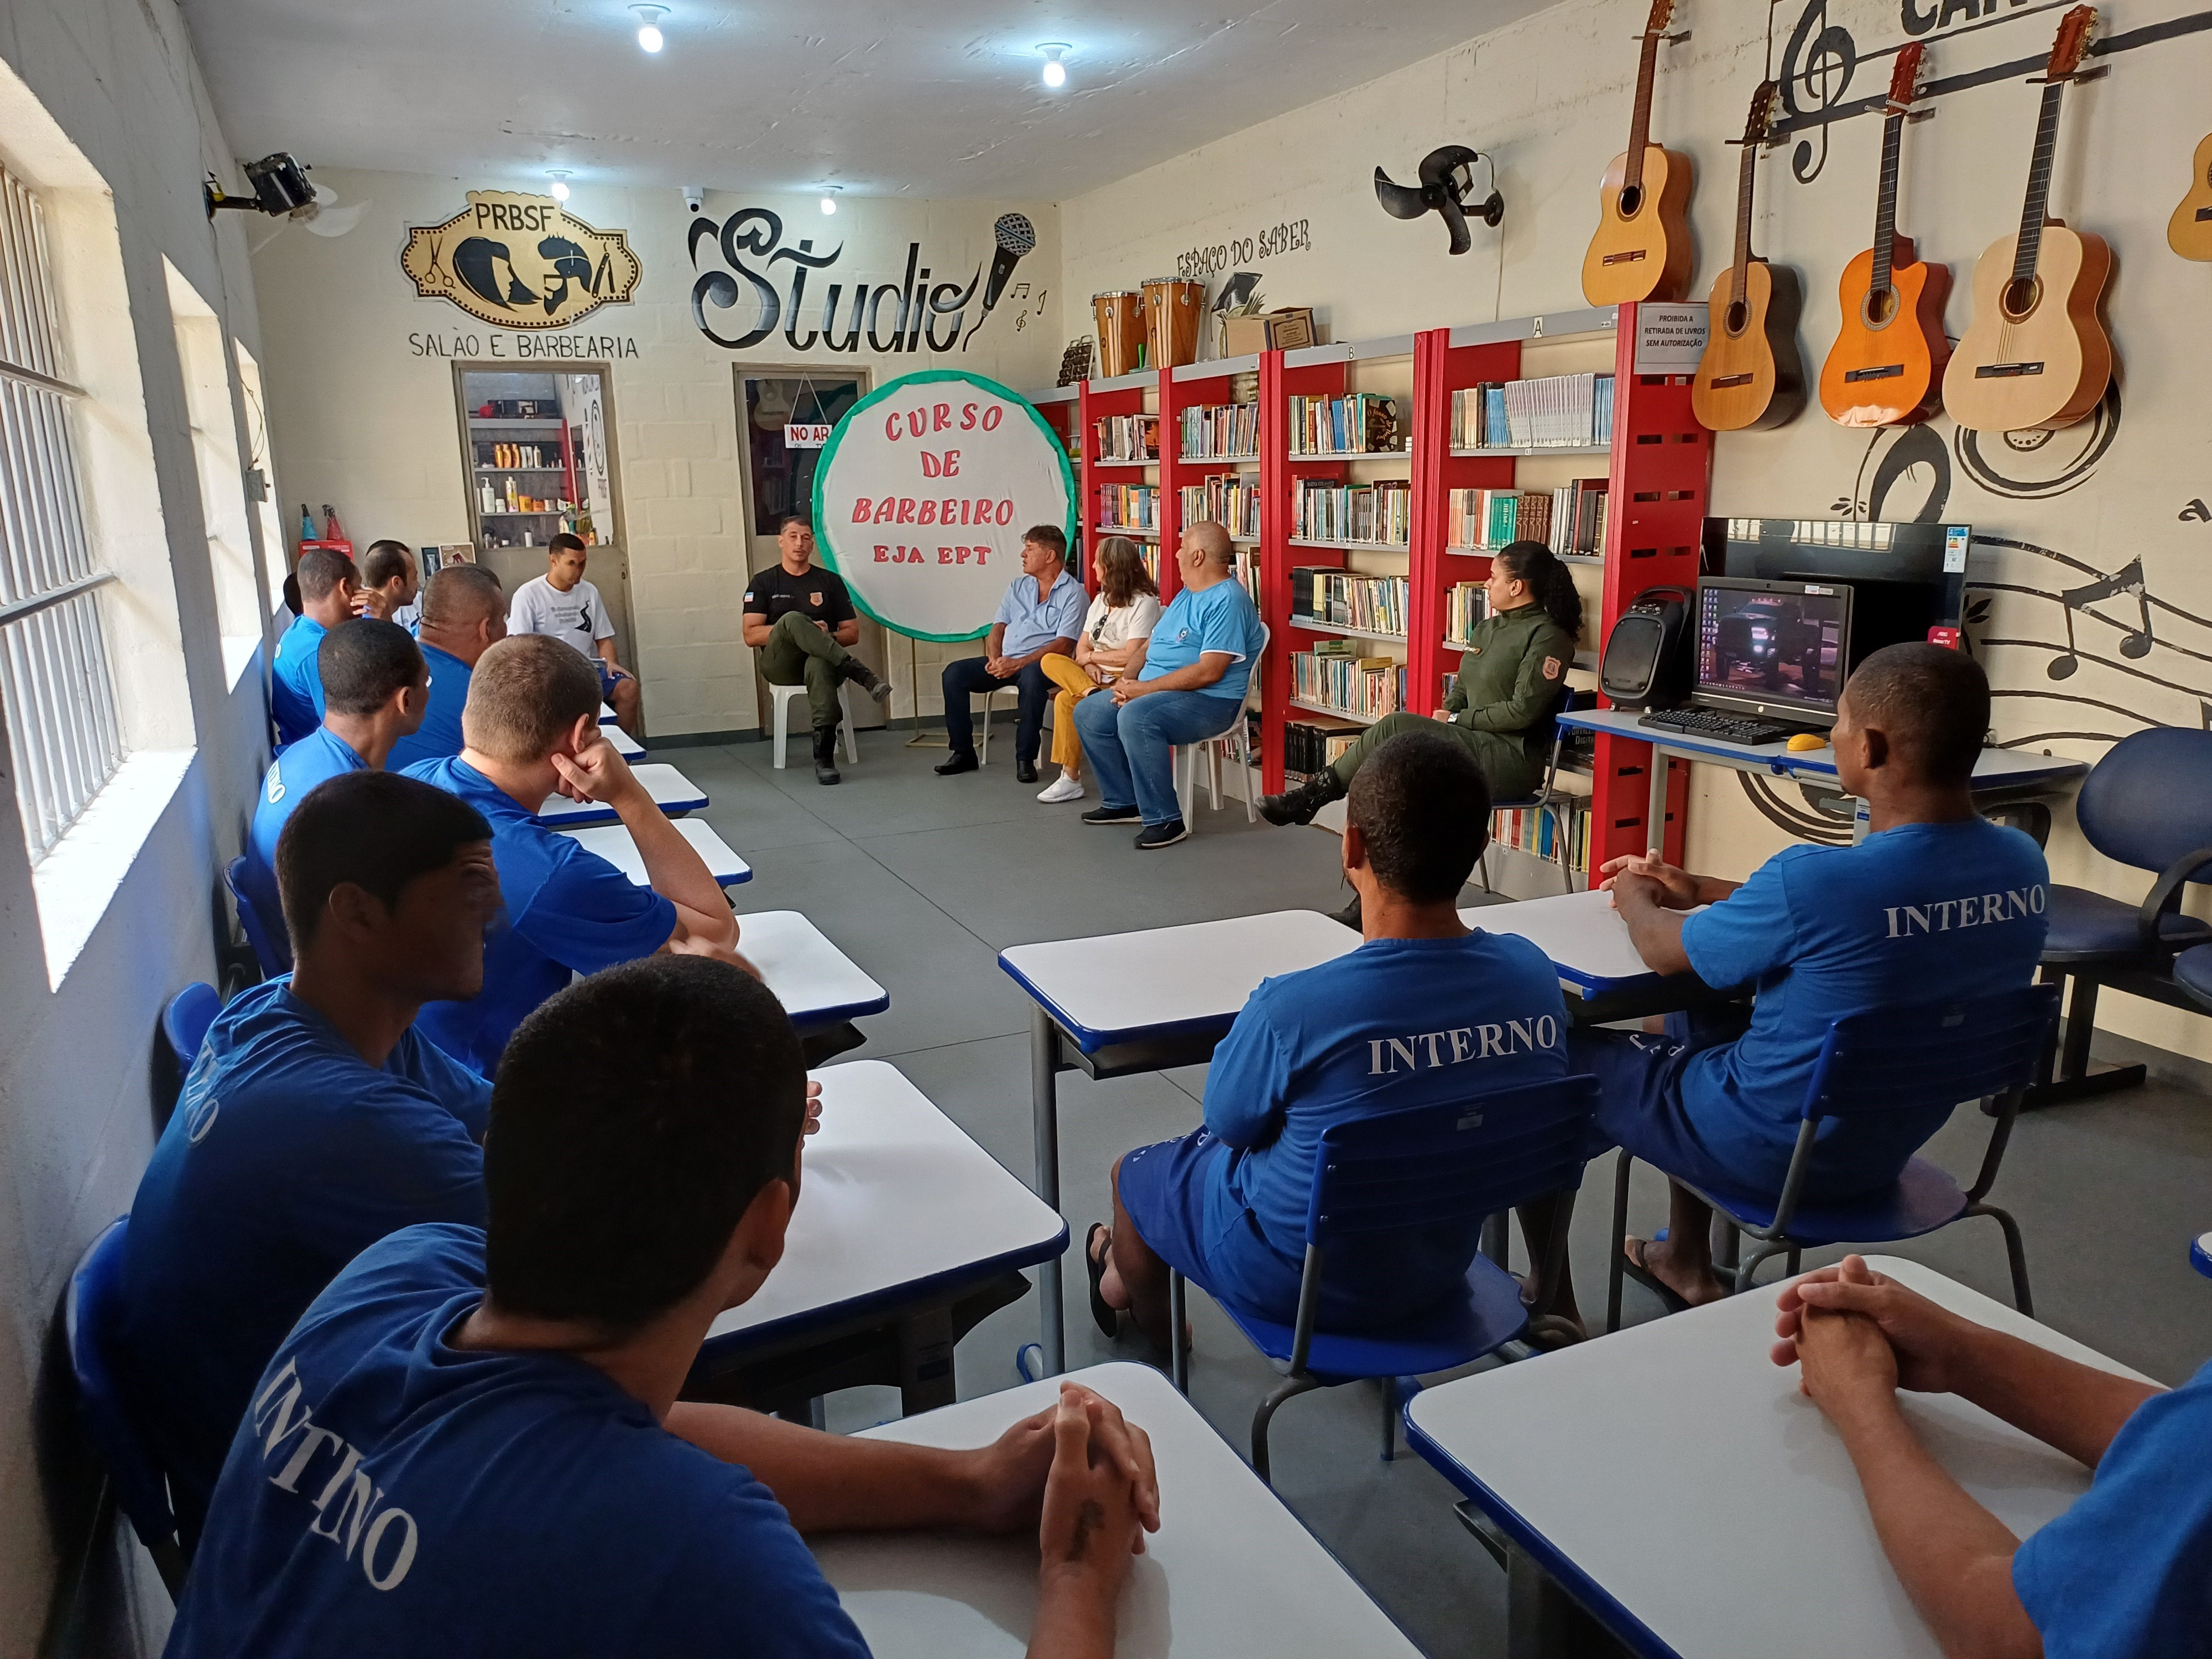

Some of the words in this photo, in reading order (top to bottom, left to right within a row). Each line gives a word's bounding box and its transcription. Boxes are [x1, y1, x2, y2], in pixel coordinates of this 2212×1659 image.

[475, 203, 555, 232] PRBSF
[1177, 245, 1227, 278] ESPAÇO
[1230, 237, 1254, 267] DO
[1259, 219, 1311, 259] SABER
[688, 208, 983, 353] Studio
[1534, 320, 1542, 335] A
[491, 335, 505, 357] E
[517, 335, 639, 358] BARBEARIA
[1349, 347, 1354, 359] B
[1660, 338, 1702, 348] AUTORIZAÇÃO
[790, 426, 808, 441] NO
[886, 403, 1003, 441] CURSO
[921, 450, 961, 478] DE
[852, 497, 1014, 526] BARBEIRO
[873, 545, 925, 564] EJA
[938, 546, 992, 565] EPT
[1883, 884, 2046, 938] INTERNO
[1367, 1015, 1557, 1075] INTERNO
